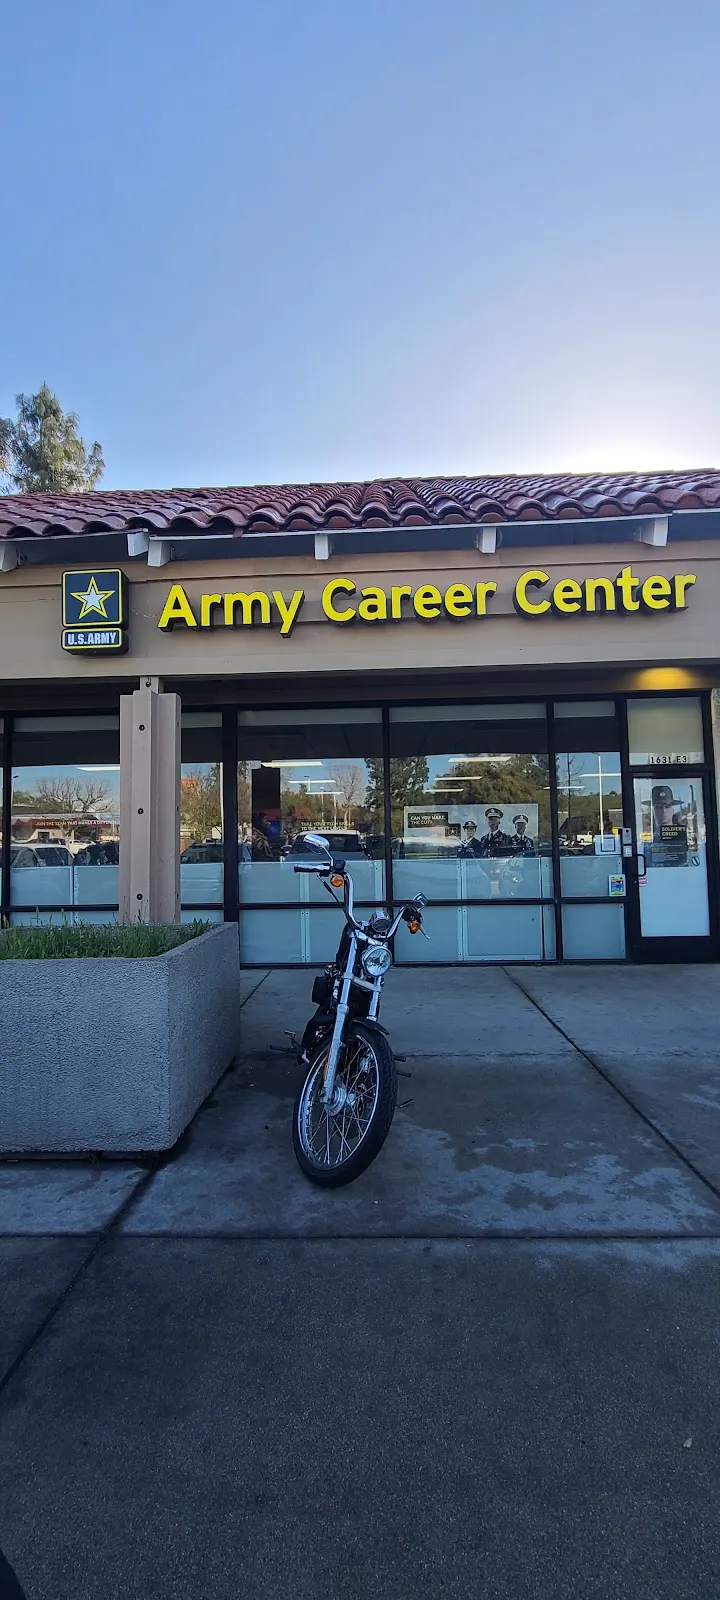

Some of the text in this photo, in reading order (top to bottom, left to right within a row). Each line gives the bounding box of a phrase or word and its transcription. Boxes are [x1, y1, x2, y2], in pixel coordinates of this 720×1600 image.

[158, 567, 697, 633] Army Career Center
[651, 756, 671, 764] 1631
